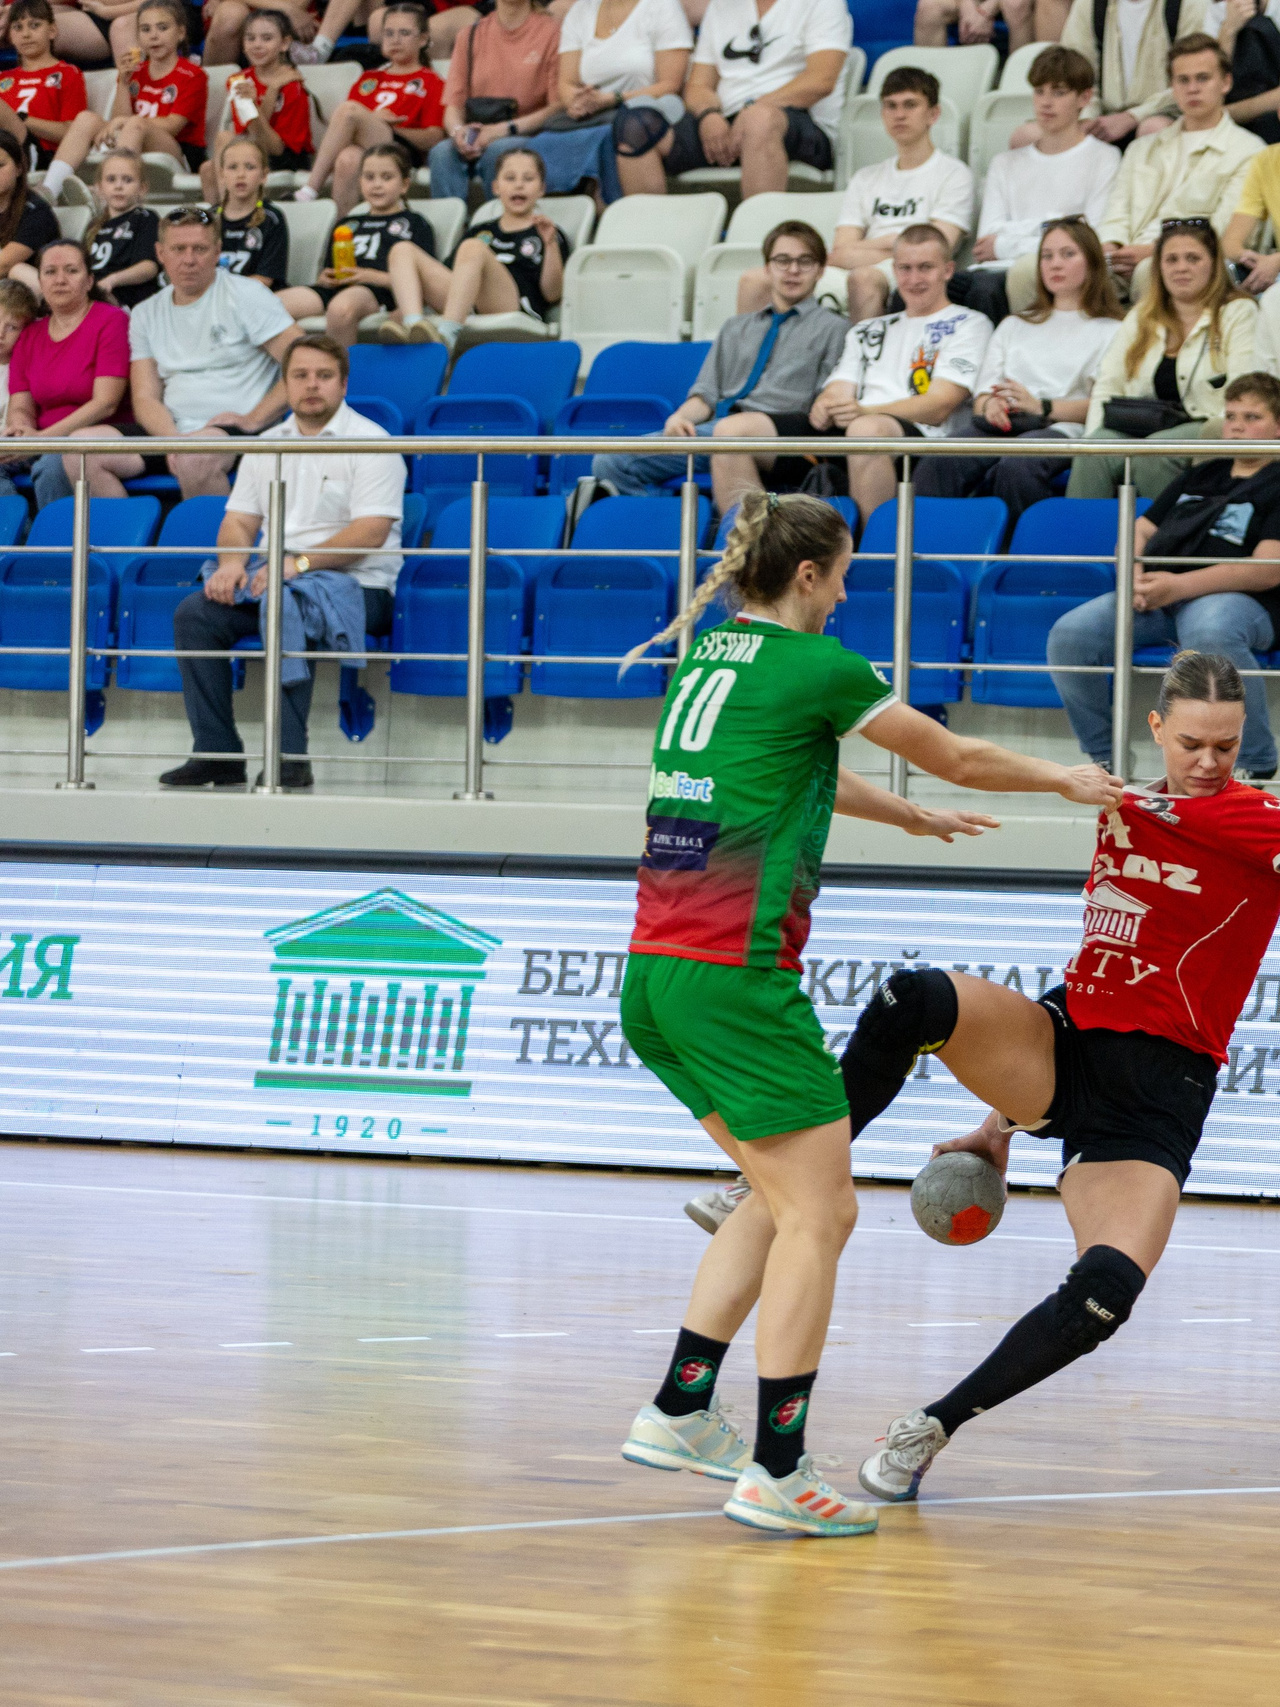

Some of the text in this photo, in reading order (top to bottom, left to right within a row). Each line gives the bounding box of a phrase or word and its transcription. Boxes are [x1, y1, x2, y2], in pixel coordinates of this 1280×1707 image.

[16, 88, 37, 113] 7
[91, 242, 113, 270] 9
[660, 667, 737, 752] 10
[655, 771, 714, 802] BelFert
[311, 1114, 403, 1139] 1920
[1085, 1297, 1115, 1321] SELECT
